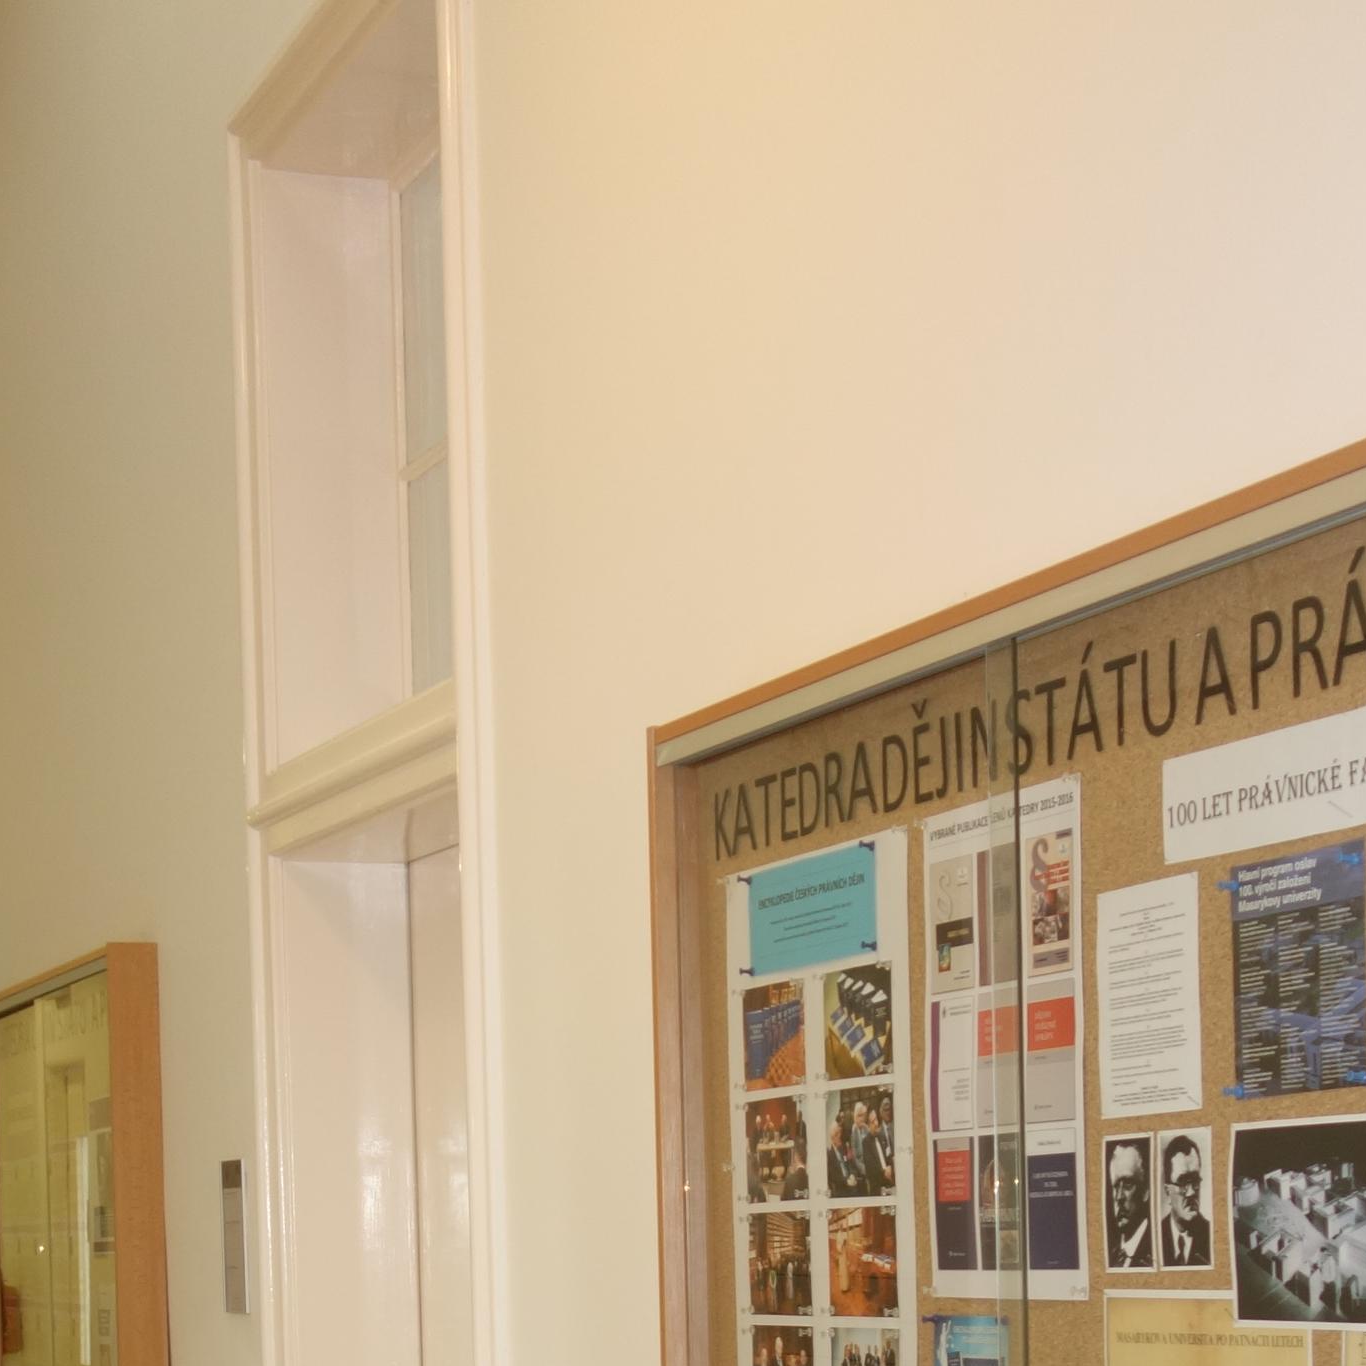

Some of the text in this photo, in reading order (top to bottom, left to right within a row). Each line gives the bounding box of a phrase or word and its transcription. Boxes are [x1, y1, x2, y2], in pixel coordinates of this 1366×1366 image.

[714, 741, 878, 861] KATEDRA
[881, 699, 998, 813] DĚJIN
[1005, 640, 1177, 777] STÁTU
[1195, 625, 1237, 726] A
[1167, 799, 1197, 829] 100
[1202, 790, 1233, 820] LET
[1237, 758, 1343, 813] PRÁVNICKÉ
[1261, 862, 1294, 881] program
